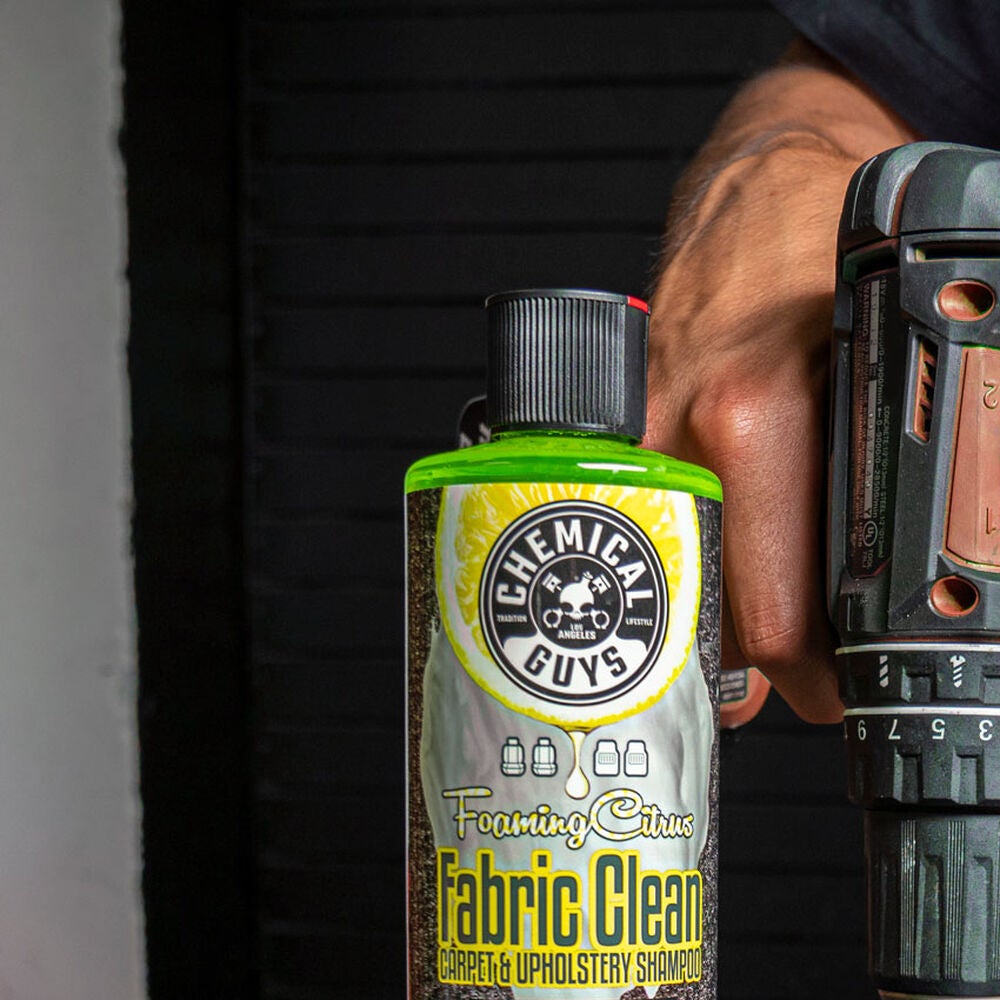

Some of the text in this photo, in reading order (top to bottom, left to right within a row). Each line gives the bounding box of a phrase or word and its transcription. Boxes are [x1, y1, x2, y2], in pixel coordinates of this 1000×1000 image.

[982, 380, 1000, 410] 2
[495, 519, 654, 608] CHEMICAL
[557, 630, 597, 640] ANGELES
[569, 623, 584, 631] LOS
[625, 617, 653, 627] LIFESTYLE
[524, 644, 628, 687] GUYS
[887, 719, 901, 740] 7
[931, 719, 946, 741] 5
[979, 719, 993, 741] 3
[442, 786, 695, 849] Foaming Citrus
[440, 851, 701, 947] Fabric Clean
[440, 947, 702, 985] CARPET & UPHOLSTERY SHAMPOO
